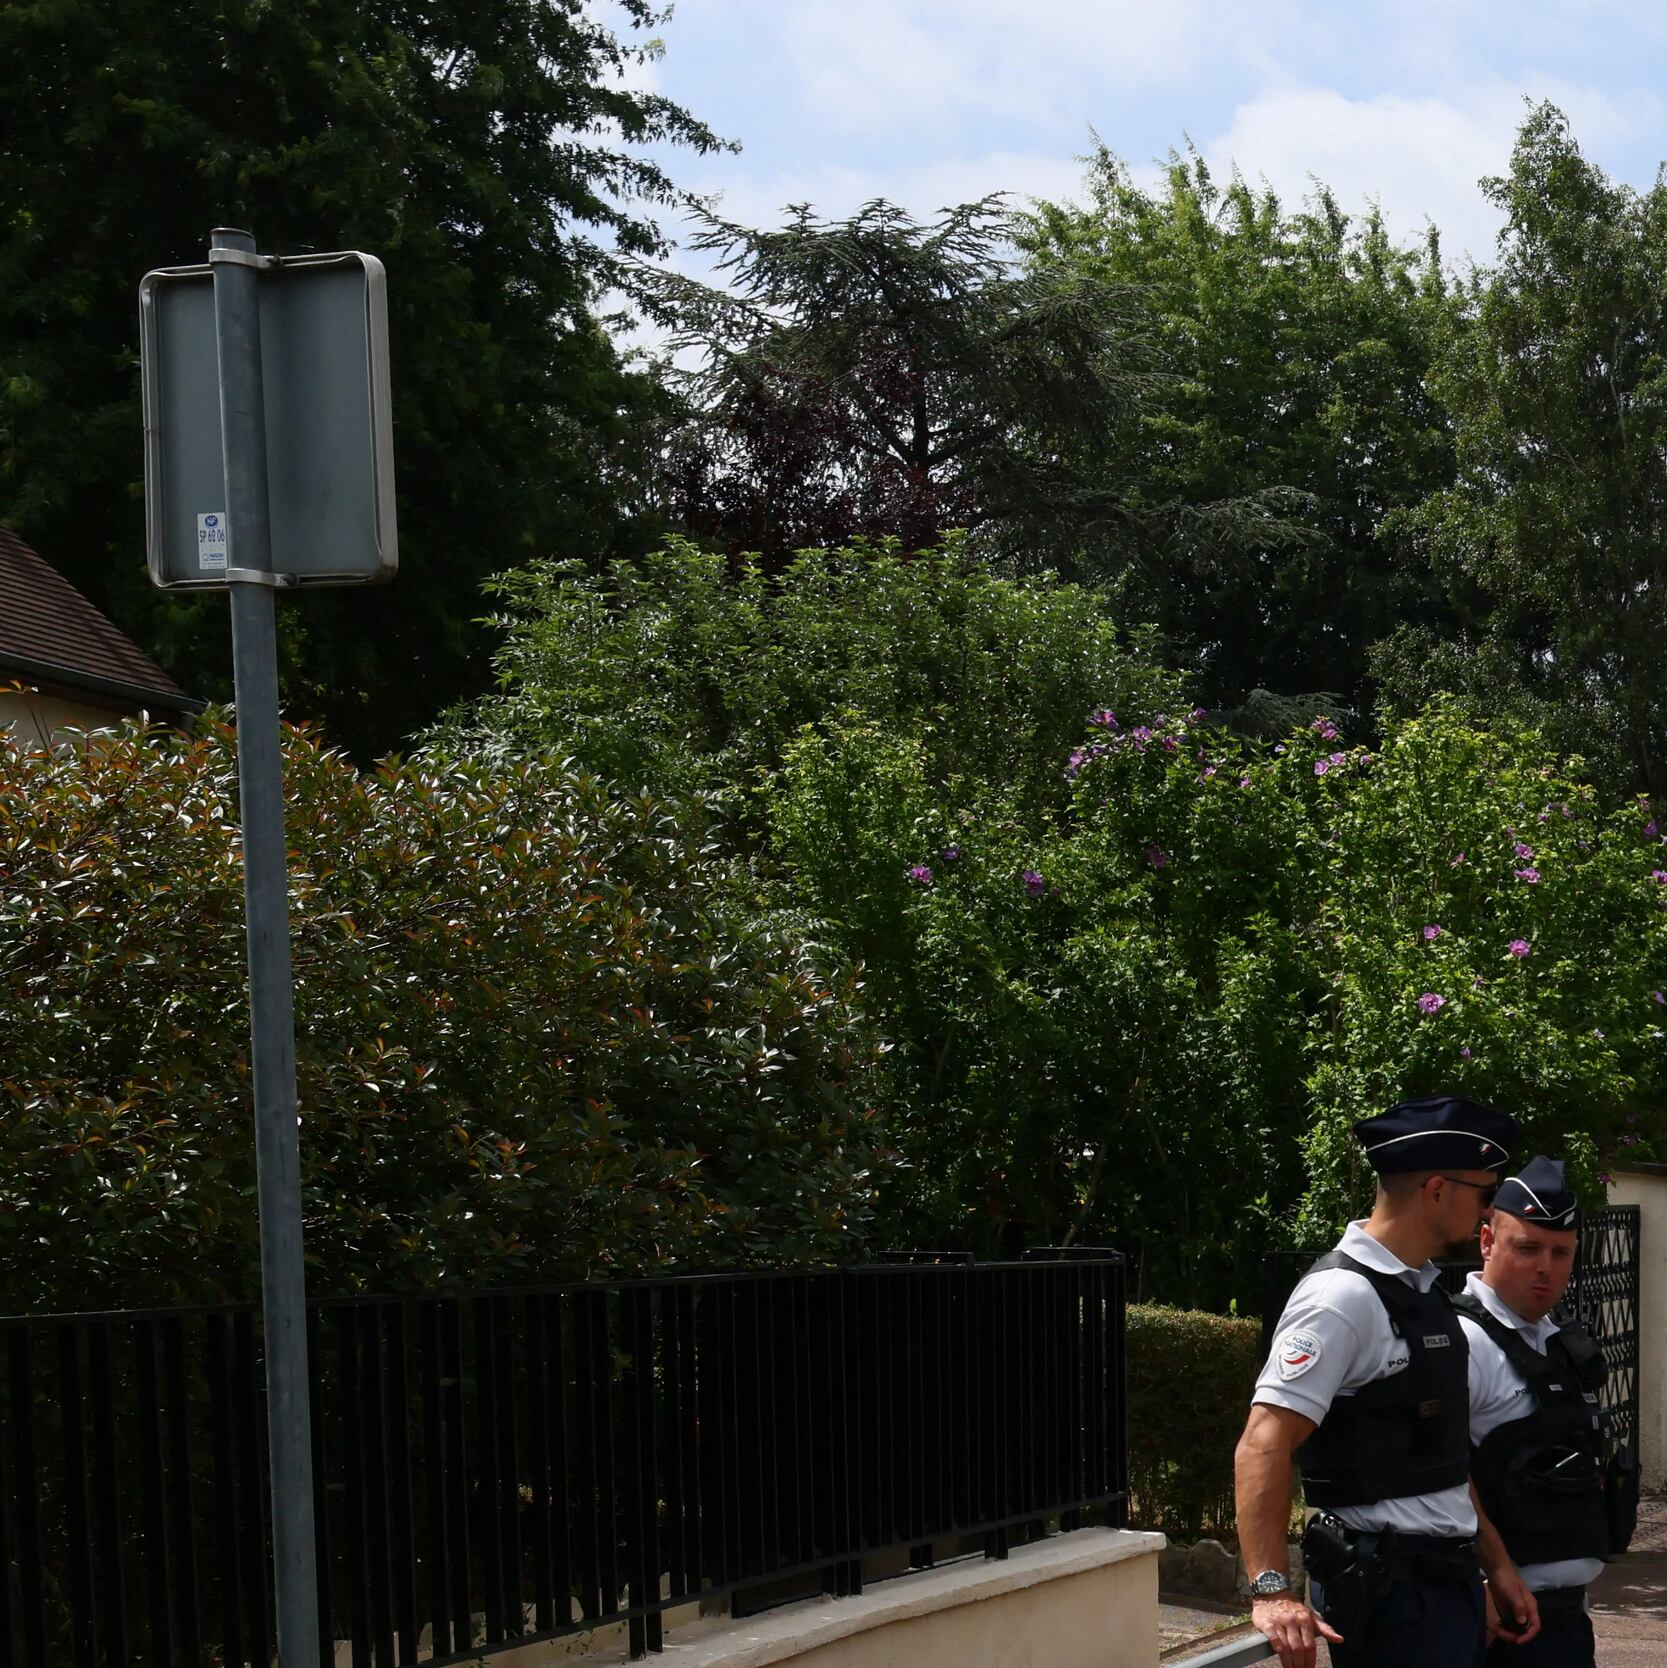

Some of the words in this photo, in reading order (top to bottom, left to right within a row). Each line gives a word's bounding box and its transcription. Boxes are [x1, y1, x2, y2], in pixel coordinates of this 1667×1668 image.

[217, 529, 225, 542] 06
[1292, 1336, 1313, 1348] POLICE
[1425, 1336, 1449, 1345] POLICE
[1284, 1341, 1317, 1357] NATIONALE
[1388, 1356, 1409, 1368] POL
